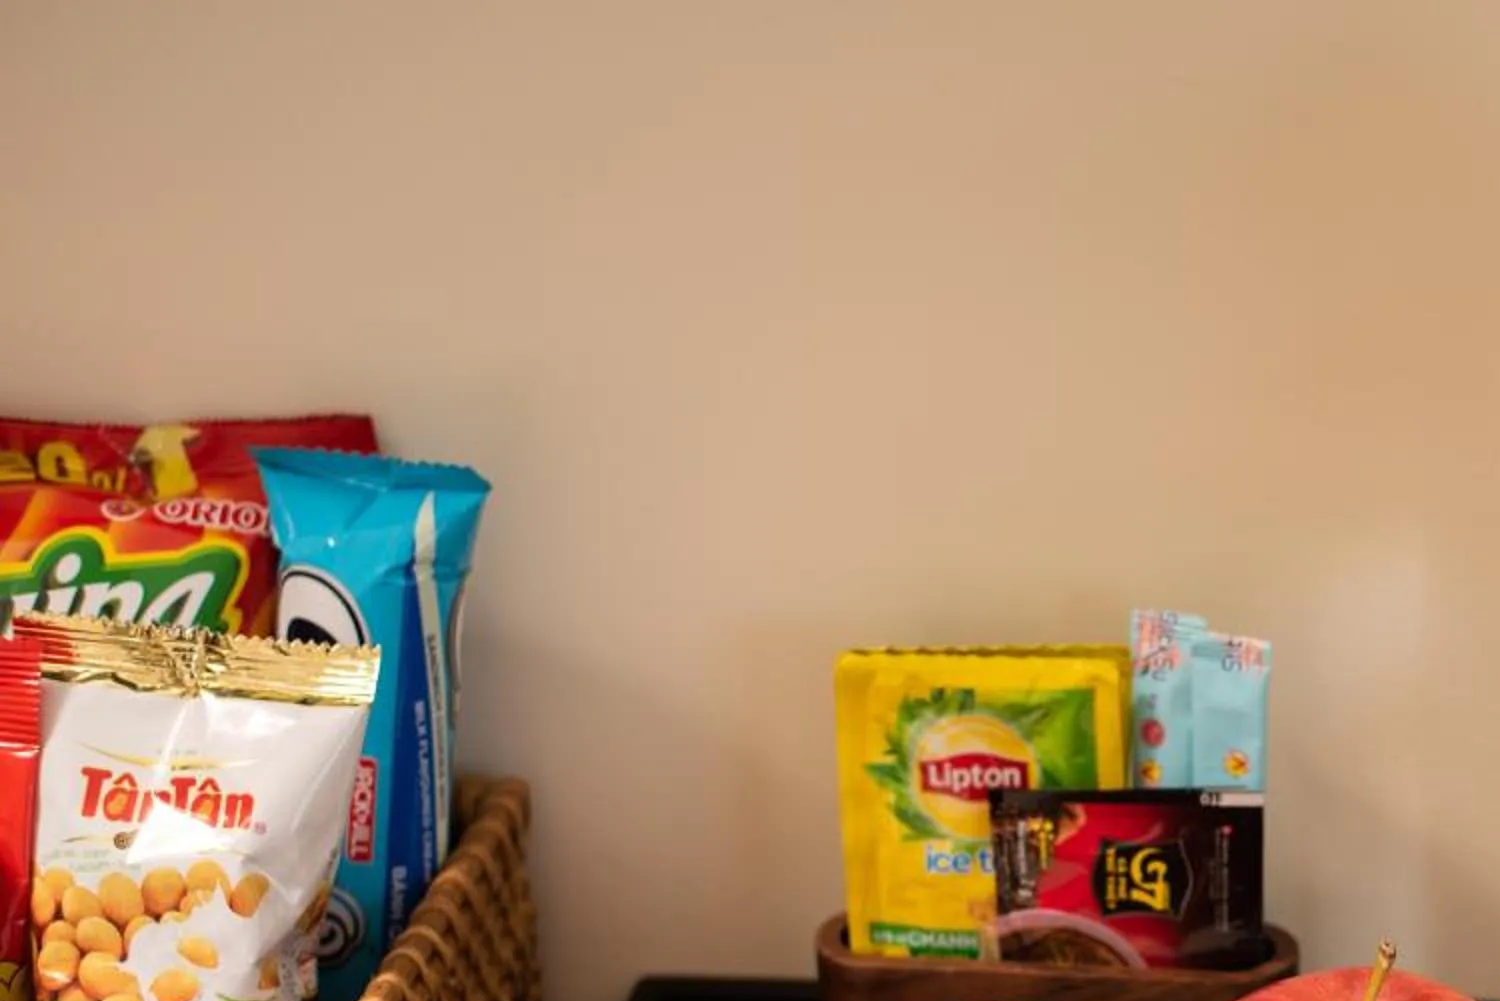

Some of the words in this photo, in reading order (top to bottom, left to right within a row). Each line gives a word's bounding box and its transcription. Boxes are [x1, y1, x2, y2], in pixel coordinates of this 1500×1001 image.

[153, 497, 269, 536] ORIO
[927, 761, 1022, 794] Lipton
[926, 844, 971, 874] ice
[1129, 847, 1170, 911] G7
